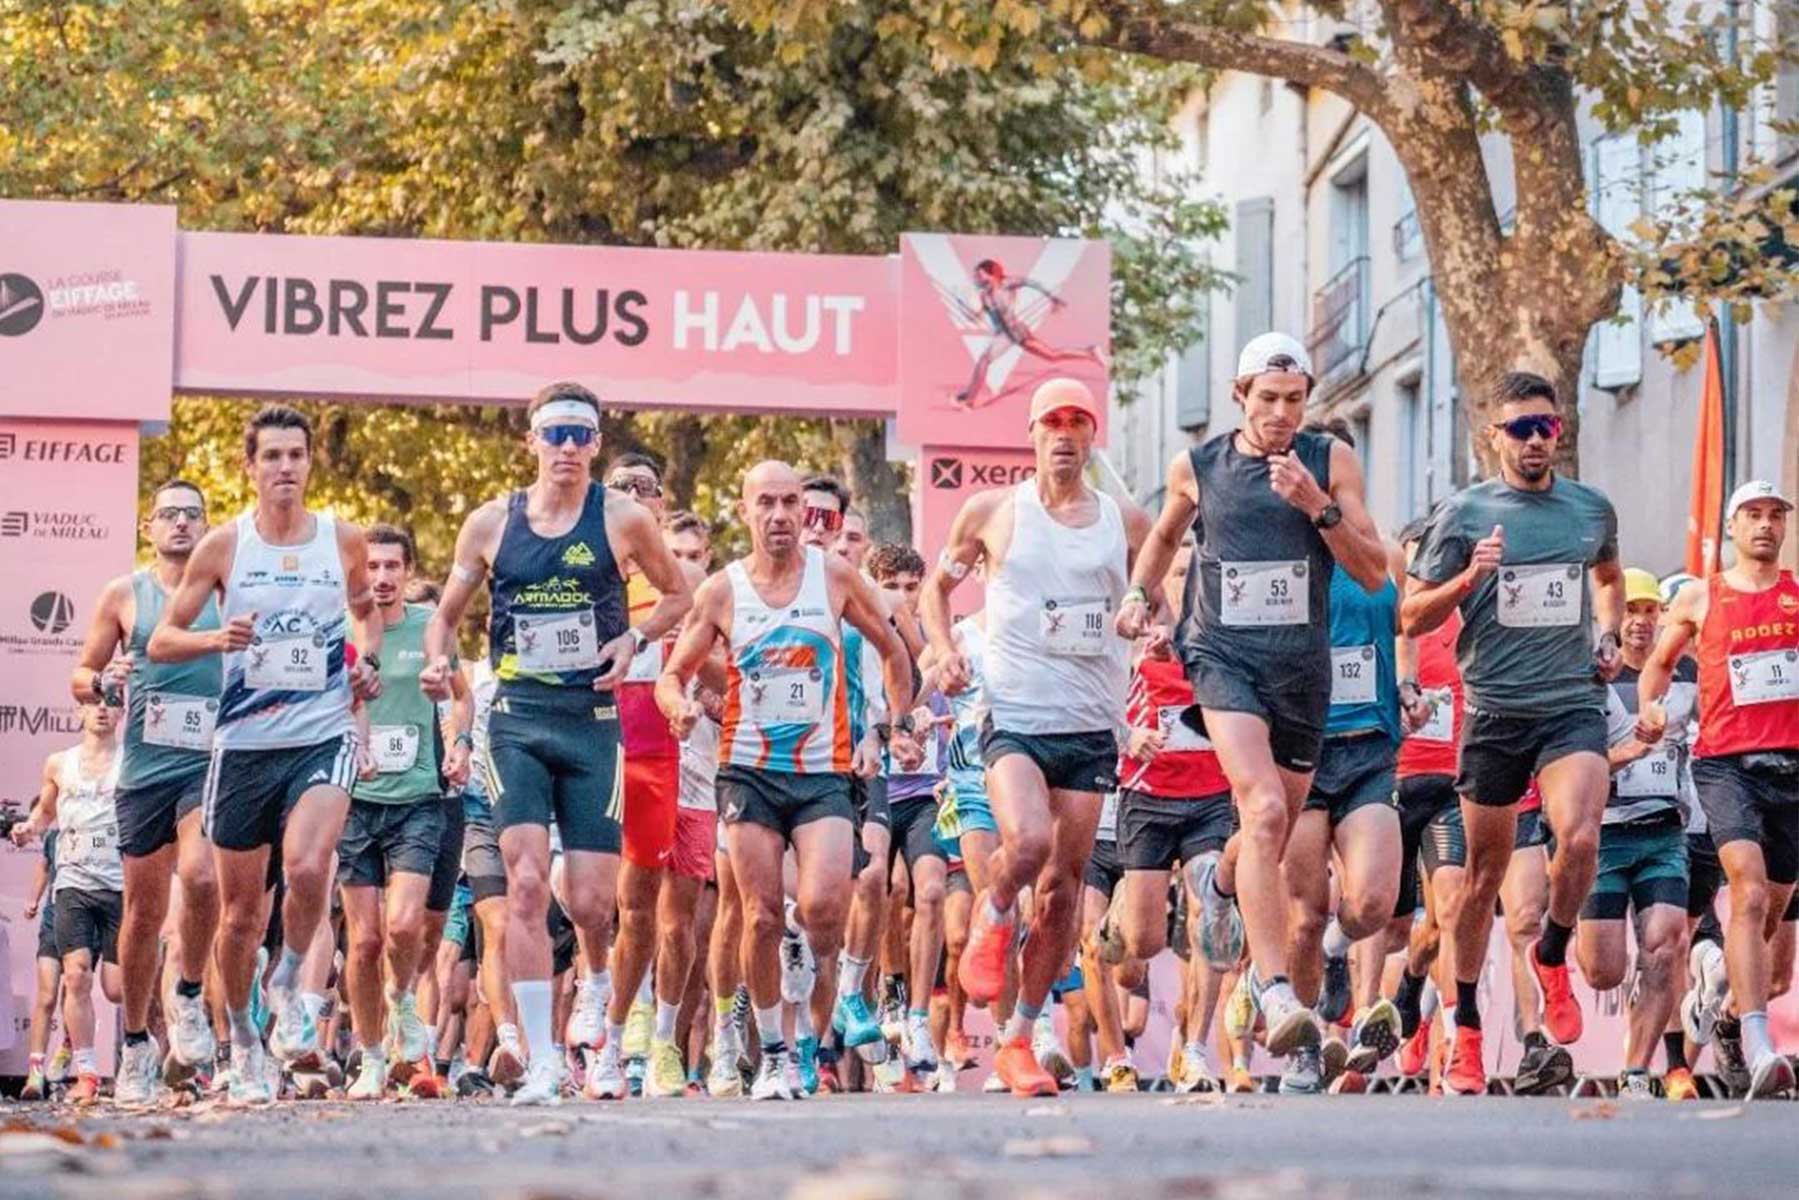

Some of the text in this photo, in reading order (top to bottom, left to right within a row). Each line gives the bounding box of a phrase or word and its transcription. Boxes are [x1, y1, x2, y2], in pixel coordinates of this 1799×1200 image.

[49, 281, 138, 308] EIFFAGE
[209, 274, 866, 355] VIBREZ PLUS HAUT
[24, 441, 128, 463] EIFFAGE
[33, 512, 97, 526] VIADUC
[50, 527, 110, 538] MILLAU
[1271, 579, 1288, 597] 53
[1547, 580, 1564, 599] 43
[1085, 611, 1103, 630] 118
[556, 629, 580, 646] 106
[1731, 622, 1796, 642] RODEZ
[291, 647, 308, 665] 92
[1340, 662, 1361, 678] 132
[1771, 664, 1783, 678] 11
[790, 683, 804, 699] 21
[185, 711, 201, 726] 65
[388, 737, 404, 751] 66
